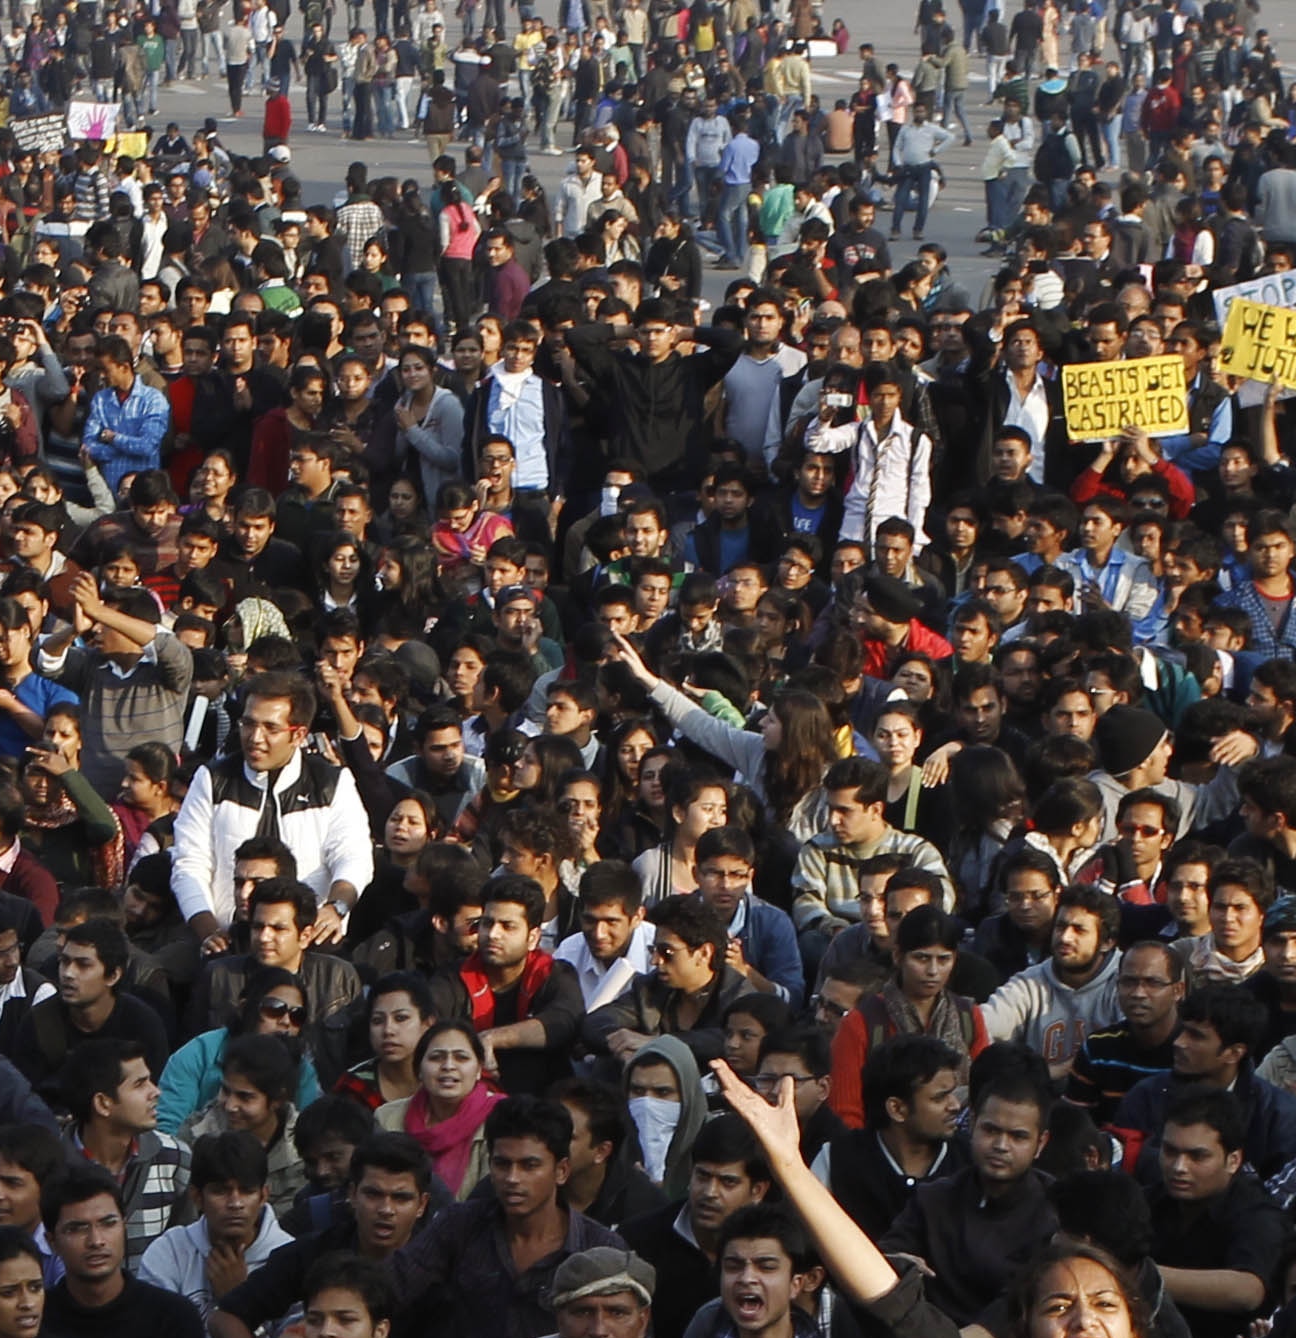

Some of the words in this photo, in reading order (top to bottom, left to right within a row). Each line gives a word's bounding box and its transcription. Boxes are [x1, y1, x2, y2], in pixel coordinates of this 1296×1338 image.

[1242, 306, 1275, 341] WE
[1065, 366, 1139, 400] BEASTS
[1144, 362, 1183, 392] GET
[1068, 395, 1185, 432] CASTRATED
